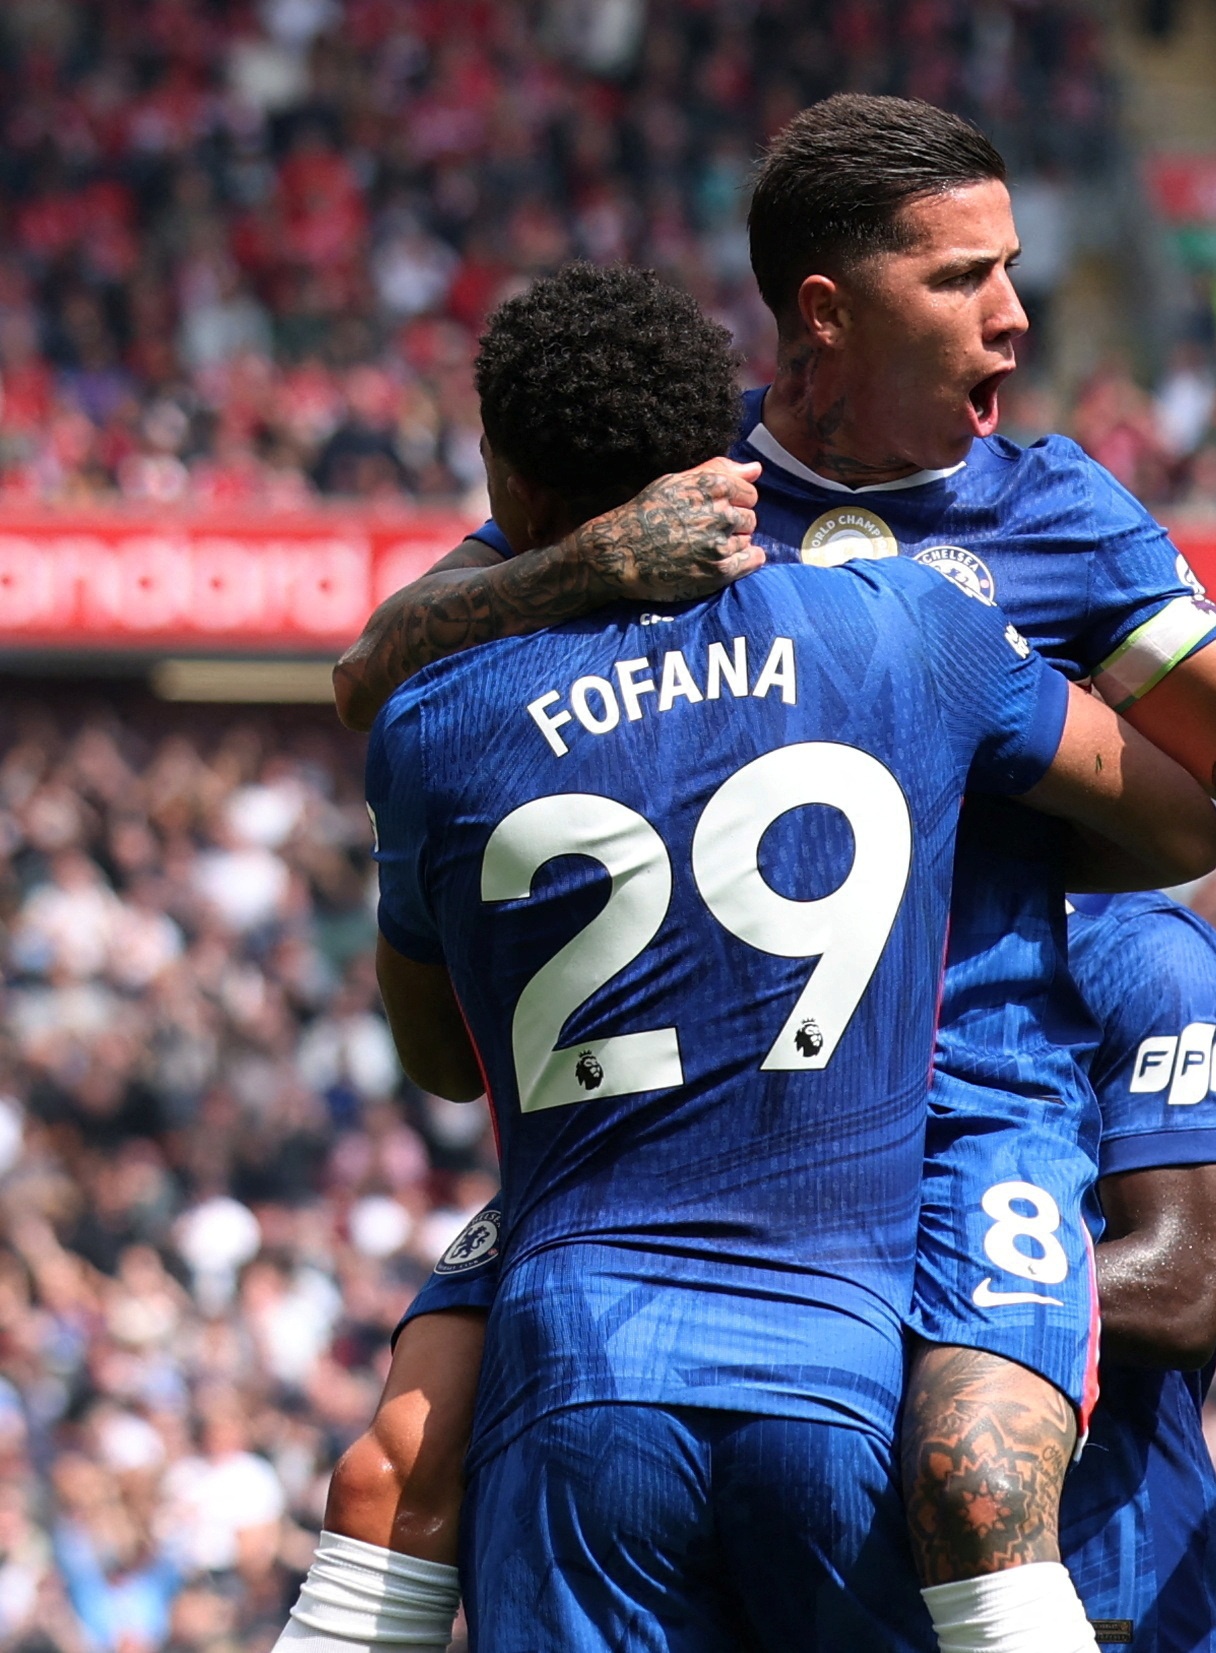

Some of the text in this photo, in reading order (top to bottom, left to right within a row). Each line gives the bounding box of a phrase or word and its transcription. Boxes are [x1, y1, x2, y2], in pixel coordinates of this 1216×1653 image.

[921, 549, 980, 573] CHELSEA
[526, 636, 798, 758] FOFANA
[480, 740, 913, 1114] 29
[981, 1180, 1069, 1285] 8
